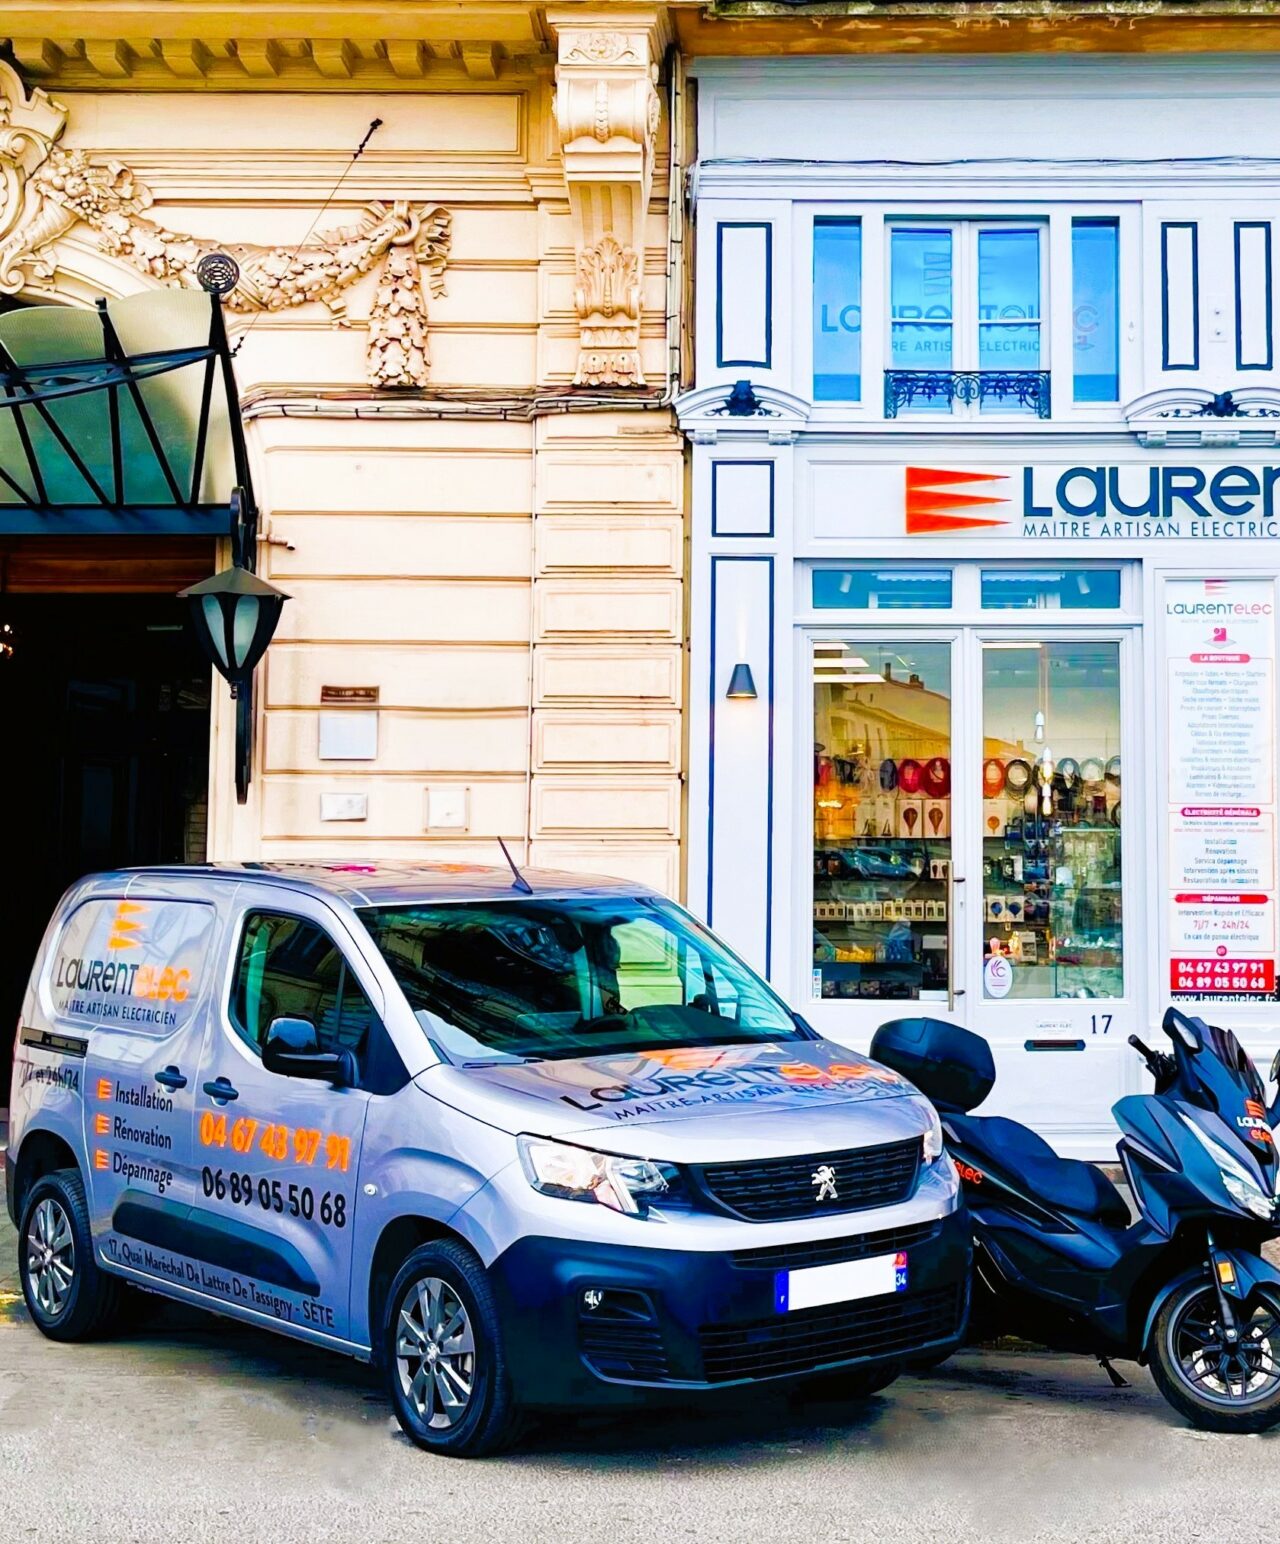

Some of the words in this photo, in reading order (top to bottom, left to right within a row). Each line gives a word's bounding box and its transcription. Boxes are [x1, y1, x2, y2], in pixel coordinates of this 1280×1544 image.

[1100, 521, 1181, 537] ARTISAN
[1178, 962, 1194, 974] 04
[1196, 962, 1211, 974] 67
[1214, 962, 1230, 974] 43
[1232, 962, 1247, 974] 97
[1250, 962, 1265, 974] 91
[1178, 976, 1194, 988] 06
[1196, 976, 1211, 988] 89
[1214, 976, 1230, 988] 05
[1232, 976, 1247, 988] 50
[1250, 976, 1265, 988] 68
[121, 1006, 177, 1025] ELECTRICIEN
[1091, 1014, 1113, 1034] 17
[115, 1080, 173, 1113] Installation
[113, 1116, 172, 1150] Rénovation
[200, 1110, 227, 1148] 04
[231, 1117, 259, 1153] 67
[259, 1123, 289, 1161] 43
[293, 1127, 322, 1166] 97
[326, 1134, 351, 1172] 91
[113, 1151, 173, 1194] Dépannage
[202, 1166, 226, 1200] 06
[230, 1172, 253, 1206] 89
[258, 1178, 284, 1214] 05
[288, 1183, 314, 1221] 50
[320, 1191, 346, 1229] 68
[122, 1242, 143, 1266] Quai
[144, 1251, 185, 1278] Maréchal
[186, 1264, 200, 1283] De
[202, 1270, 231, 1294] Lattre
[233, 1277, 248, 1300] De
[249, 1282, 293, 1321] Tassigny
[302, 1296, 335, 1328] SÈTE
